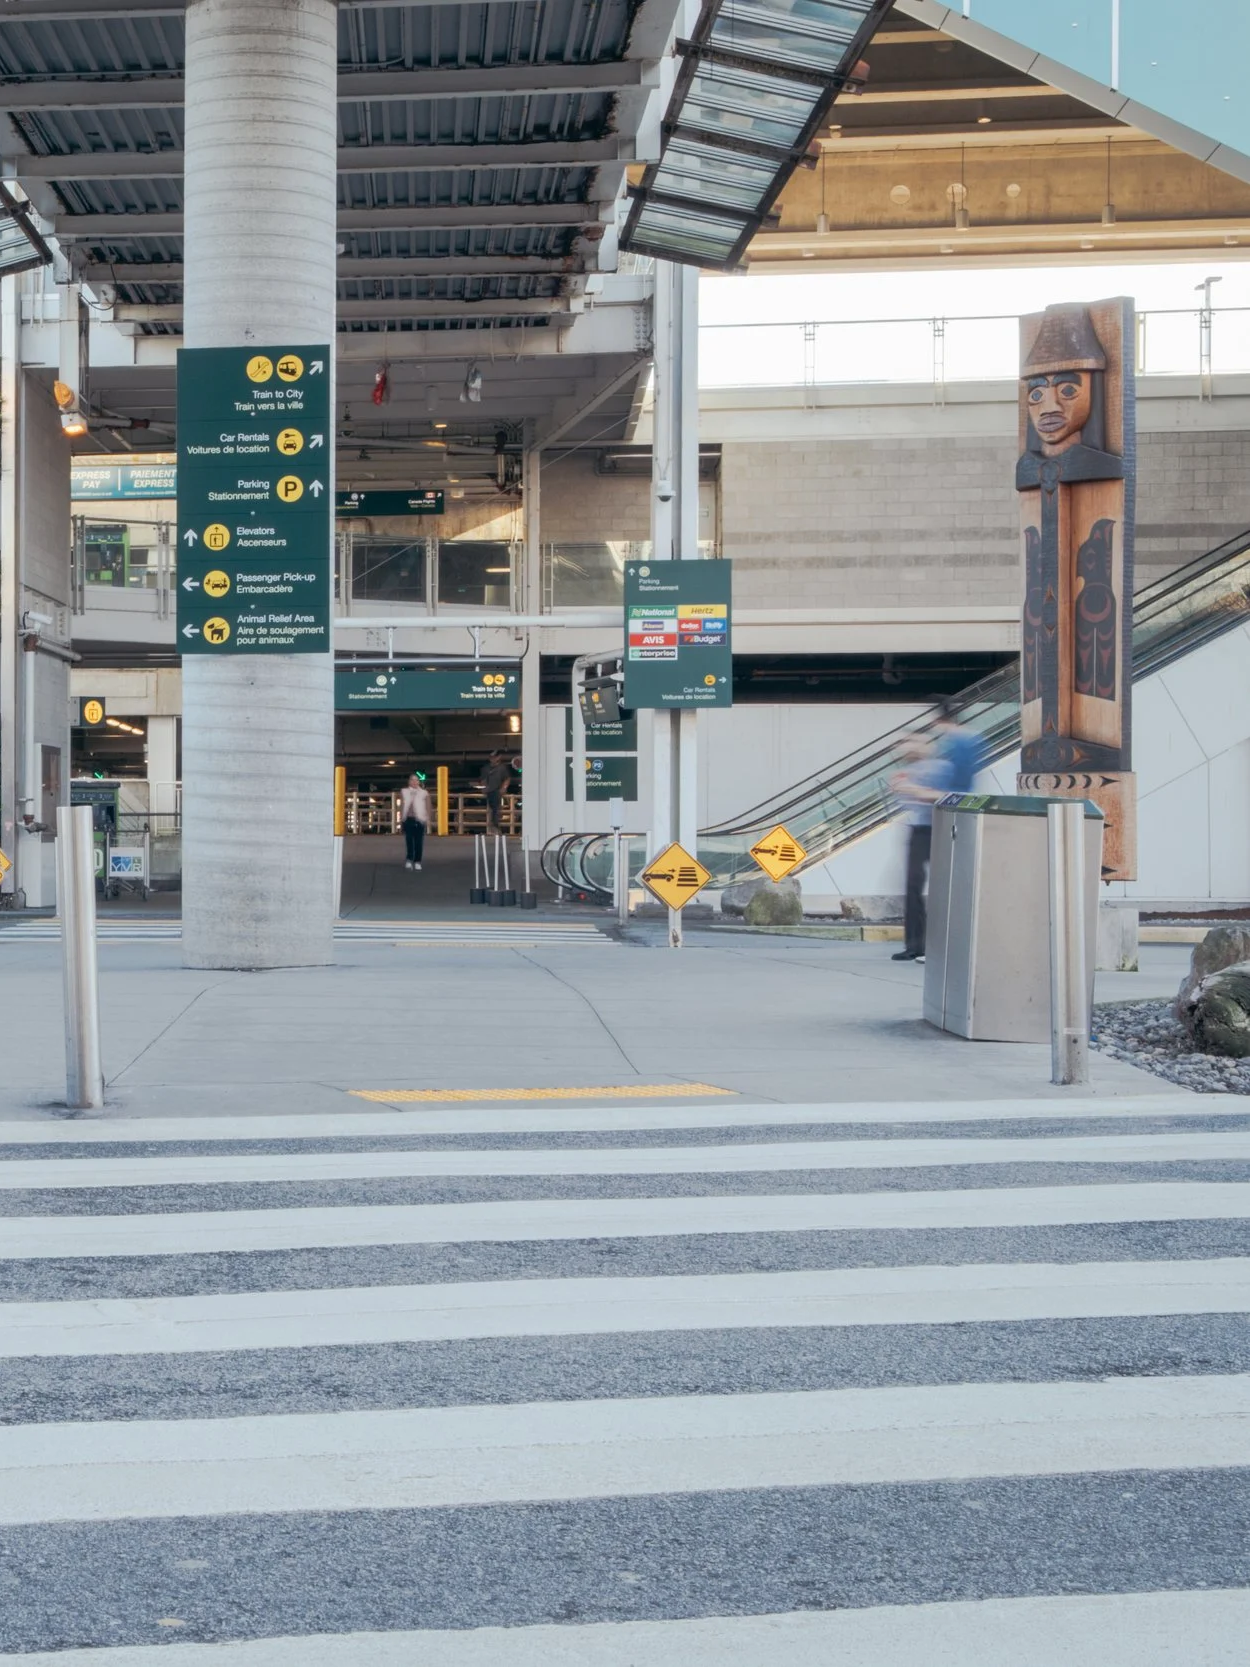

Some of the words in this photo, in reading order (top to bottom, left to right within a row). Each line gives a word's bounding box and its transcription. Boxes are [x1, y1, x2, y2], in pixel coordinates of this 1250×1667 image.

[252, 390, 273, 399] Train
[275, 389, 284, 398] to
[286, 389, 304, 400] City
[234, 402, 255, 411] Train
[278, 401, 285, 409] la
[287, 401, 303, 409] ville
[219, 433, 235, 442] Car
[238, 432, 270, 442] Rentals
[187, 446, 221, 454] Voitures
[223, 445, 234, 453] de
[236, 445, 270, 453] location
[71, 470, 110, 480] EXPRESS
[130, 469, 177, 478] PAIEMENT
[82, 480, 101, 489] PAY
[134, 479, 174, 488] EXPRESS
[237, 480, 270, 490] Parking
[284, 481, 297, 497] P
[208, 491, 270, 501] Stationnement
[236, 527, 275, 535] Elevators
[237, 538, 287, 547] Ascenseurs
[236, 573, 281, 583] Passenger
[283, 573, 316, 582] Pick-up
[236, 584, 293, 594] Embarcadère
[641, 608, 675, 617] National
[237, 615, 266, 623] Animal
[268, 614, 292, 623] Relief
[294, 614, 315, 622] Area
[237, 626, 254, 635] Aire
[256, 626, 267, 634] de
[269, 625, 324, 636] soulagement
[236, 637, 256, 646] pour
[258, 636, 294, 644] animaux
[642, 636, 665, 644] AVIS
[693, 635, 721, 644] Budget
[366, 686, 387, 694] Parking
[111, 863, 142, 872] YVR
